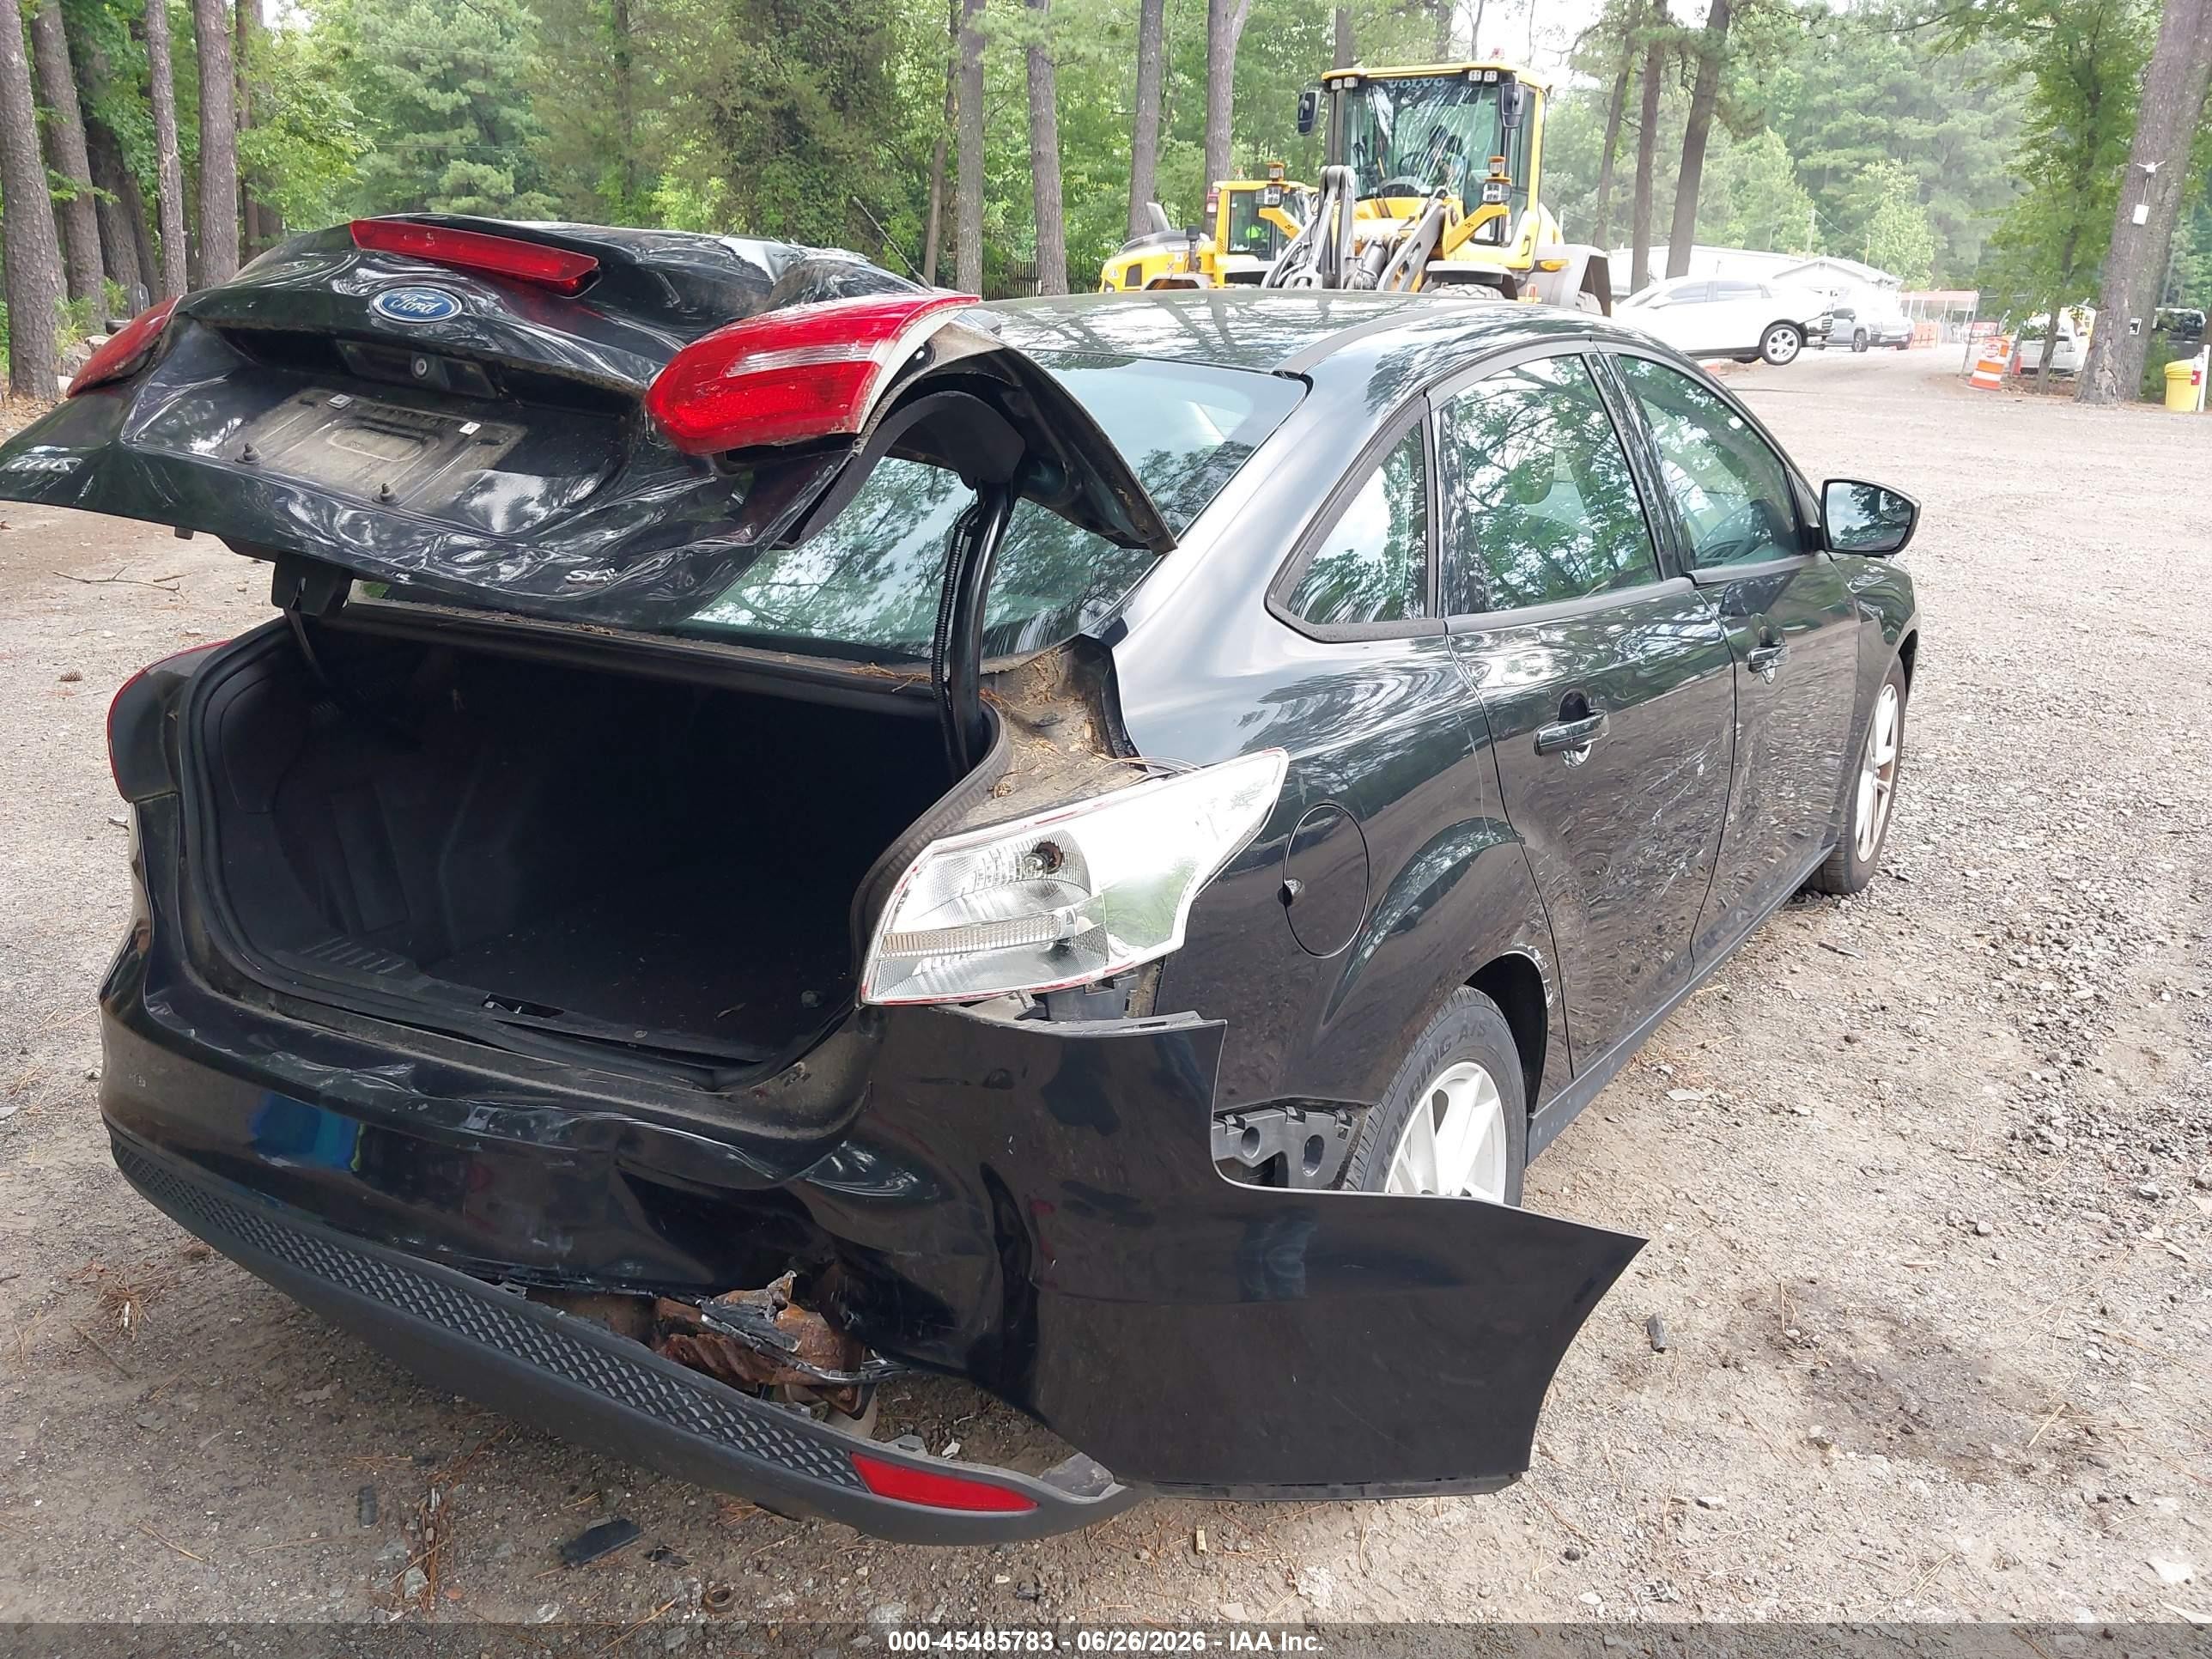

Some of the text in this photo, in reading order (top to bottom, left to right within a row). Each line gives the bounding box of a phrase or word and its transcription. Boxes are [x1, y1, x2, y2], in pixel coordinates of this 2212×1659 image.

[1386, 77, 1445, 89] VOLVO
[388, 293, 443, 314] Ford
[1376, 1033, 1452, 1180] TOURING
